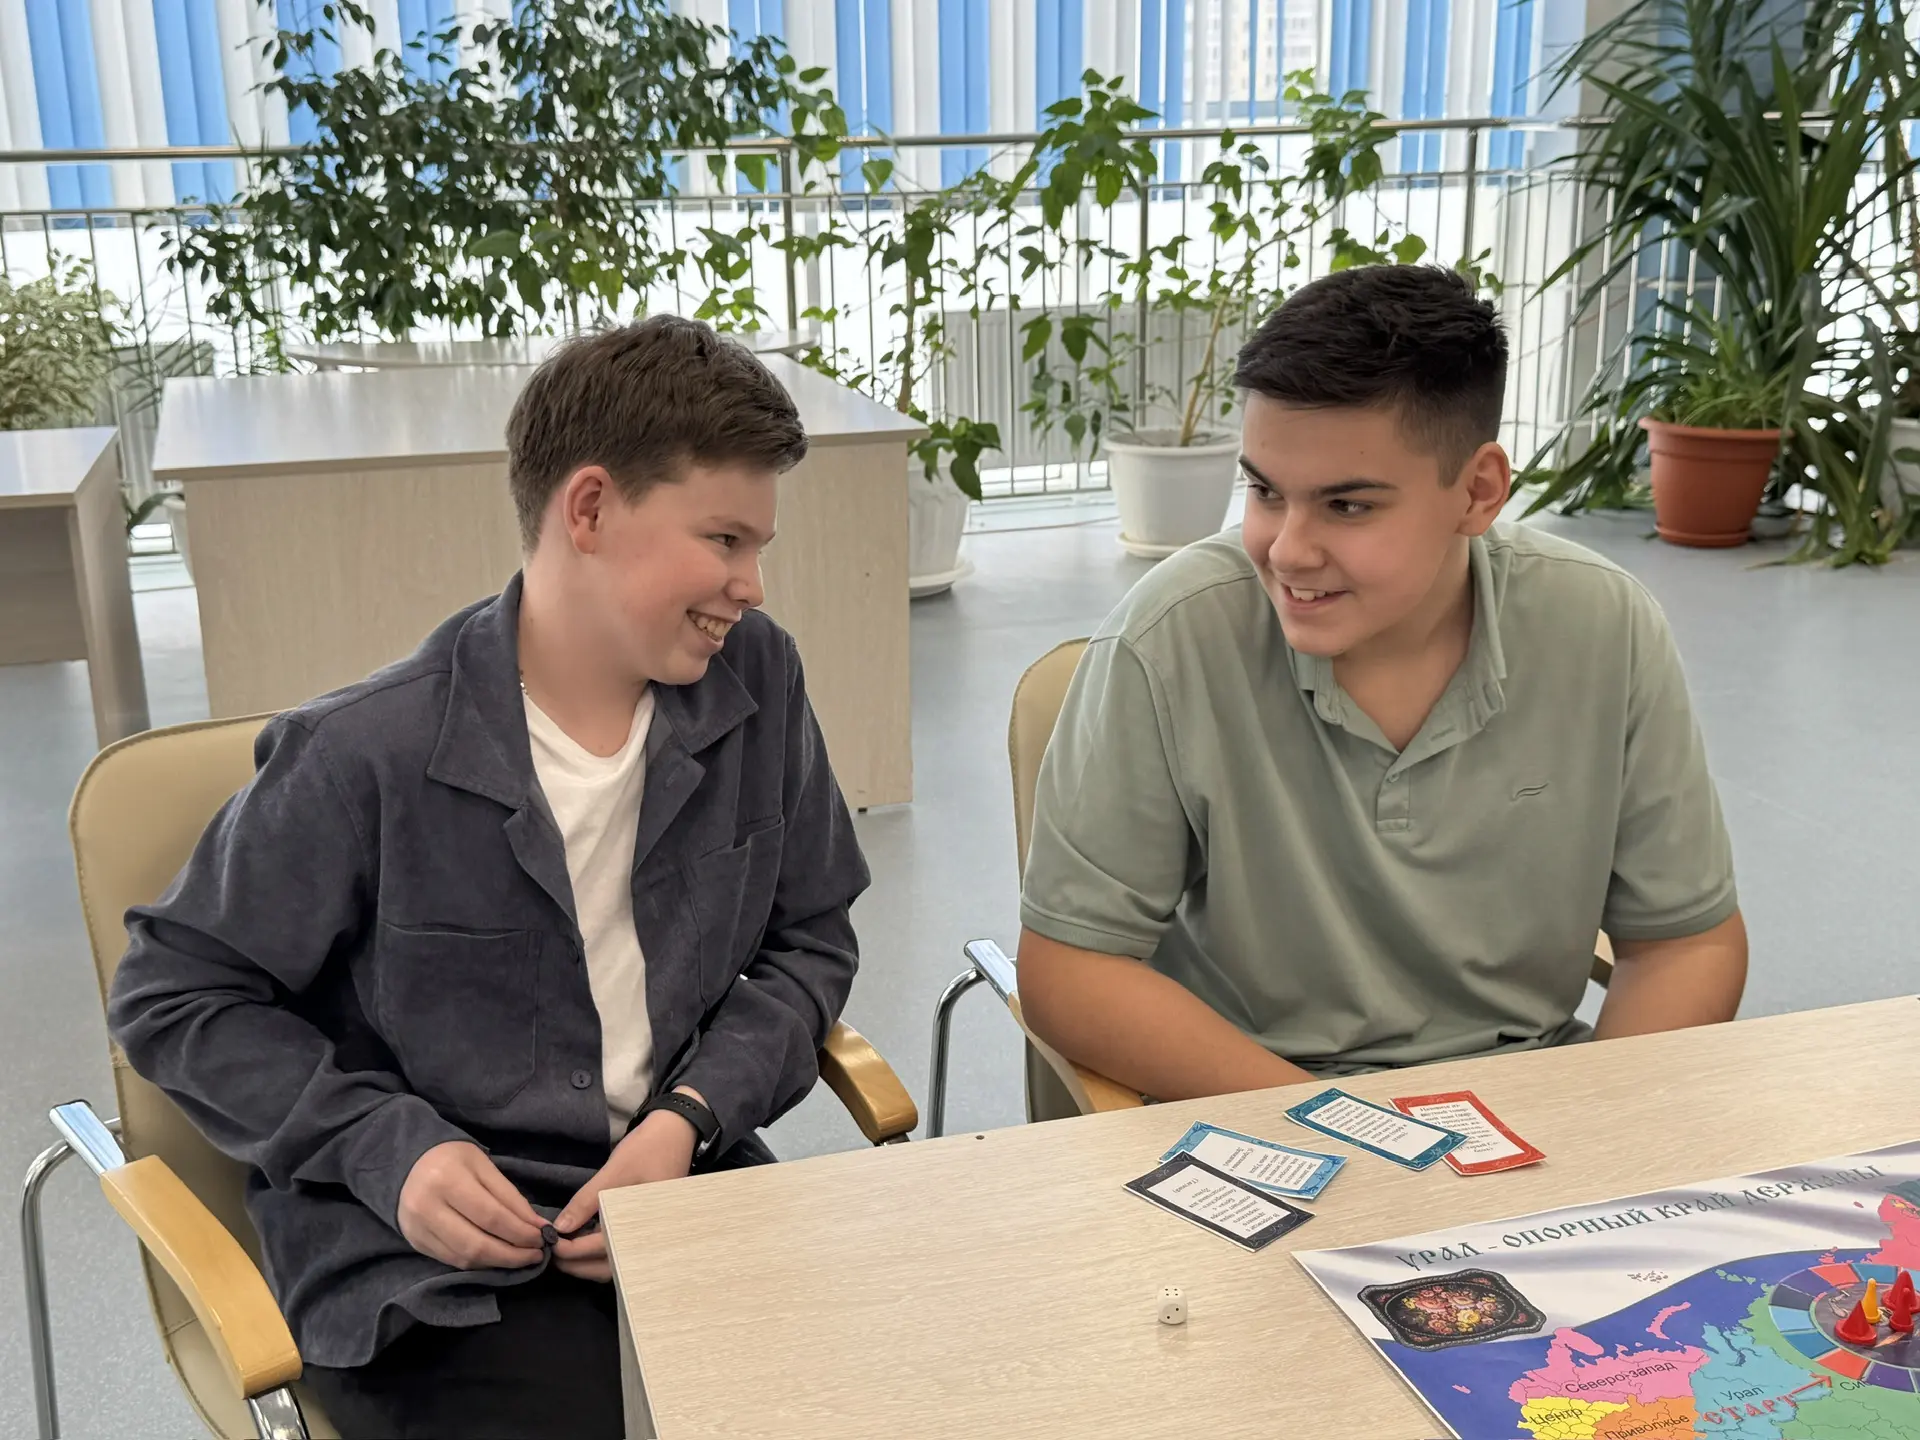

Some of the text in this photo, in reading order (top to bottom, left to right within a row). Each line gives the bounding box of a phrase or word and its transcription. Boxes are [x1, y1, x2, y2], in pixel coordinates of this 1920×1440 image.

[1395, 1241, 1484, 1271] УРАЛ
[1502, 1208, 1656, 1248] ОПОРНЫЙ
[1652, 1192, 1736, 1219] КРАЙ
[1565, 1361, 1678, 1393] Северо-запад
[1840, 1377, 1869, 1392] Си
[1720, 1386, 1764, 1402] Урал
[1529, 1408, 1583, 1427] Центр
[1702, 1393, 1799, 1425] СТАРТ
[1604, 1415, 1690, 1440] Приволжье
